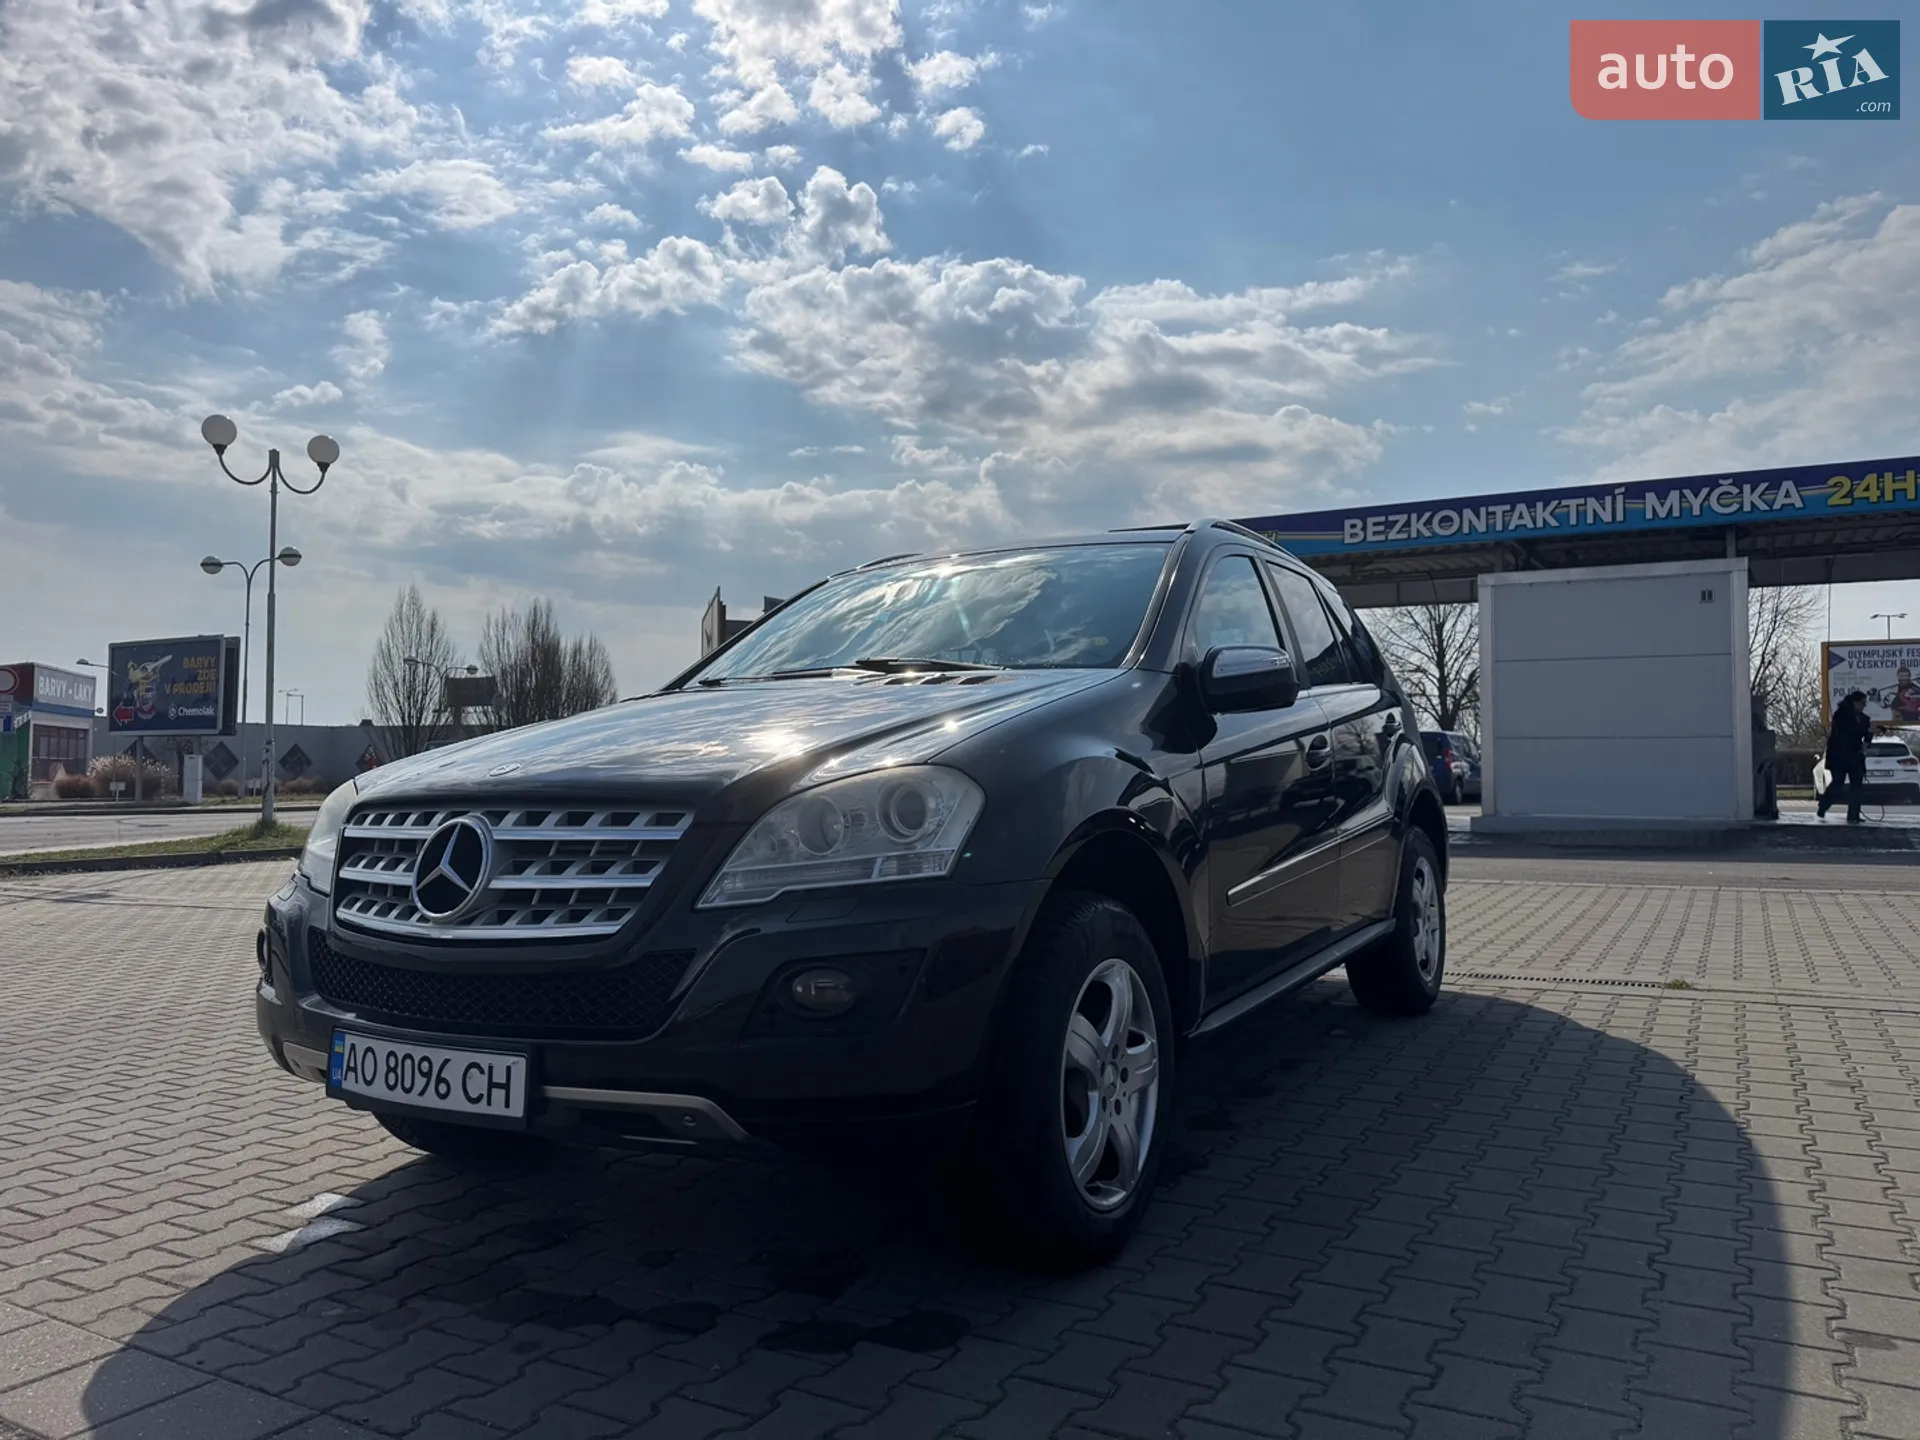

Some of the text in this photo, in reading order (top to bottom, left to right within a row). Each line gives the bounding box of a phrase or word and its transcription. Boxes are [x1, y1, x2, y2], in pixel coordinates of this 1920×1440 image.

[1343, 470, 1916, 544] BEZKONTAKTNÍ MYČKA 24H
[1848, 647, 1903, 660] OLYMPIJSKÝ
[183, 656, 216, 668] BARVY
[1848, 661, 1854, 669] V
[1900, 658, 1920, 668] BUD
[197, 669, 216, 681] ZDE
[39, 675, 67, 699] BARVY
[74, 682, 93, 703] LAKY
[164, 683, 171, 694] V
[178, 705, 215, 716] Chemolak
[332, 1068, 341, 1080] UA
[344, 1042, 512, 1109] AO 8096 CH
